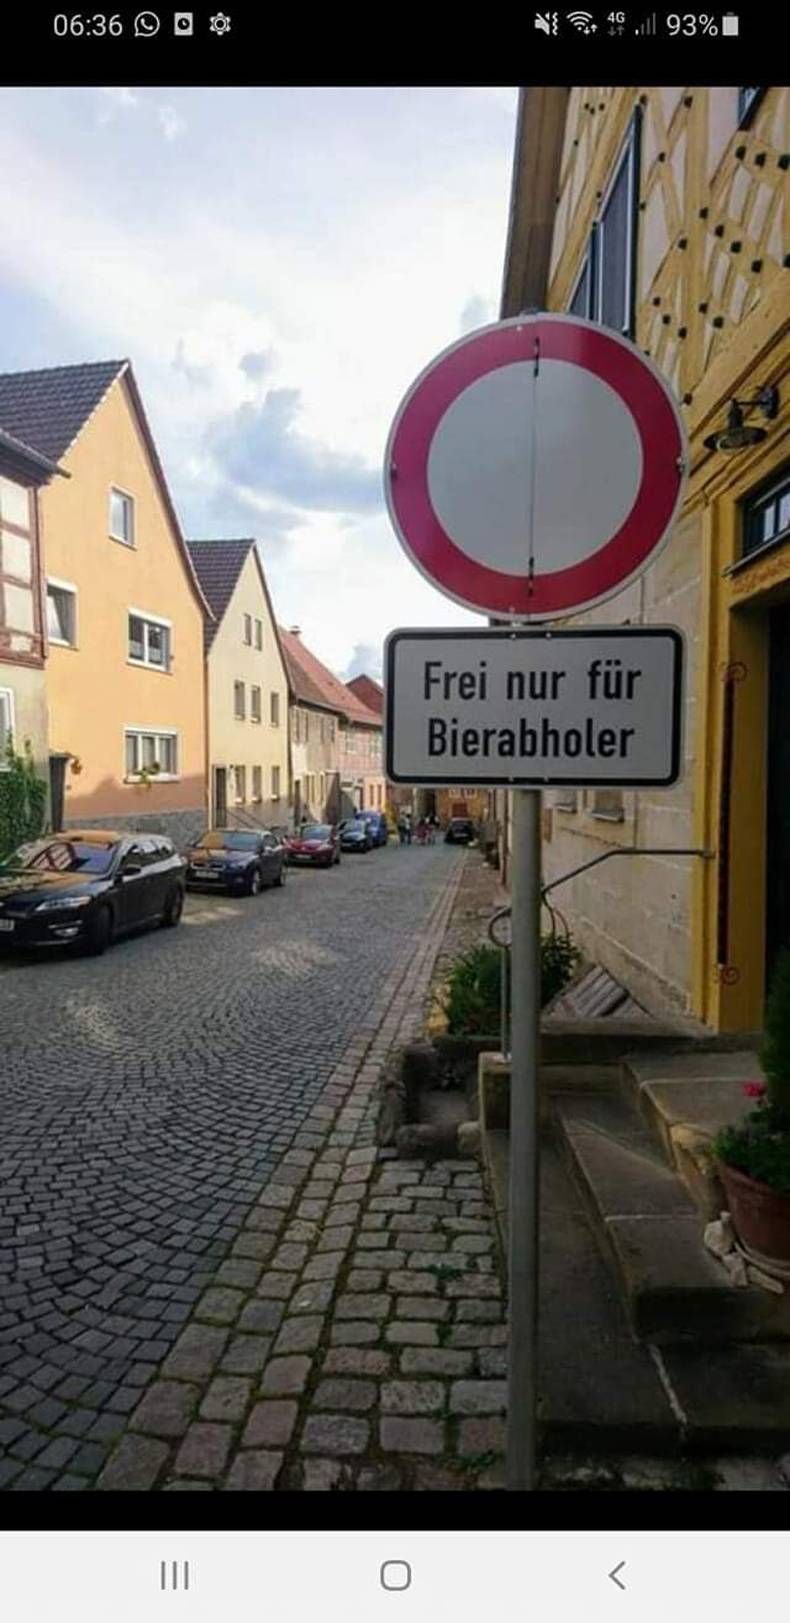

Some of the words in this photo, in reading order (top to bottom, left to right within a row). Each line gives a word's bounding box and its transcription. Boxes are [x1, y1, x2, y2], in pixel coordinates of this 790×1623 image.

[424, 660, 487, 701] Frei
[506, 669, 567, 701] nur
[586, 658, 643, 701] für
[427, 716, 636, 759] Bierabholer
